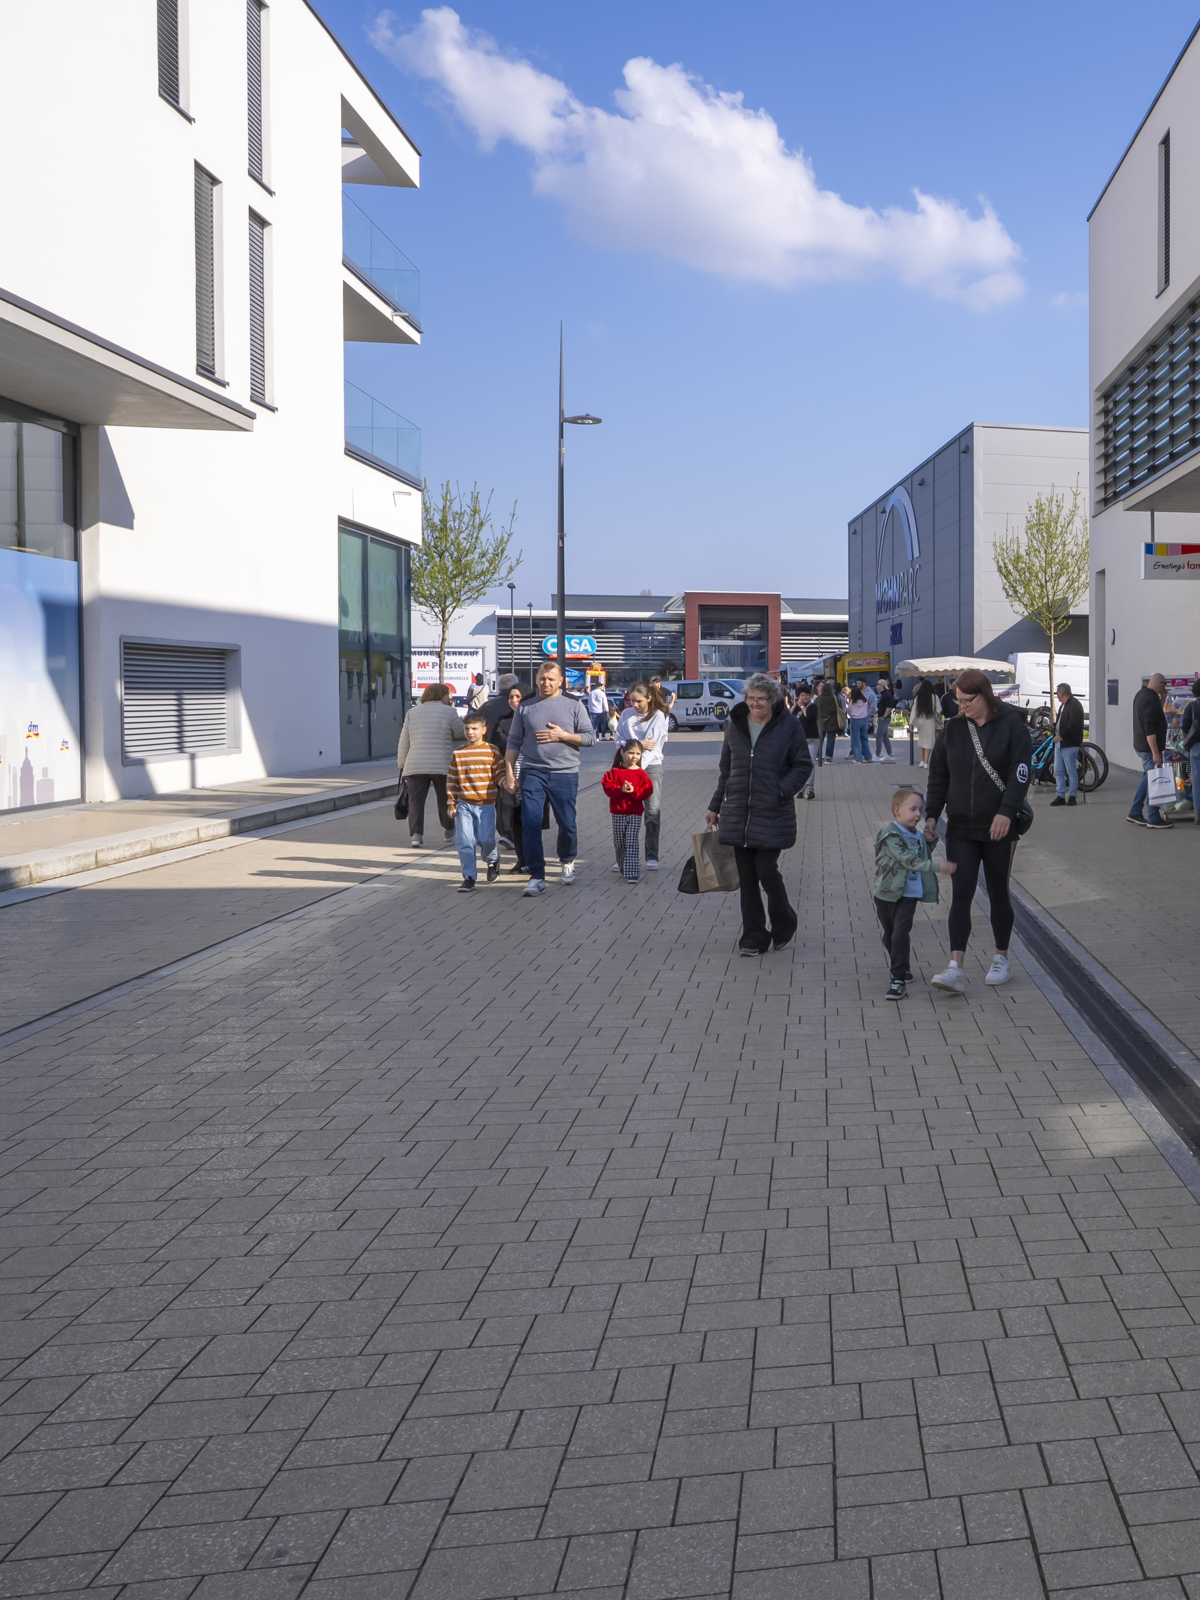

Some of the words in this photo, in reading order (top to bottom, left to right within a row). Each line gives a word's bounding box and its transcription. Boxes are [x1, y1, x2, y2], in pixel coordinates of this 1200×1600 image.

[431, 661, 468, 670] Plster
[685, 706, 729, 717] LAMPIFY
[28, 721, 39, 733] dm
